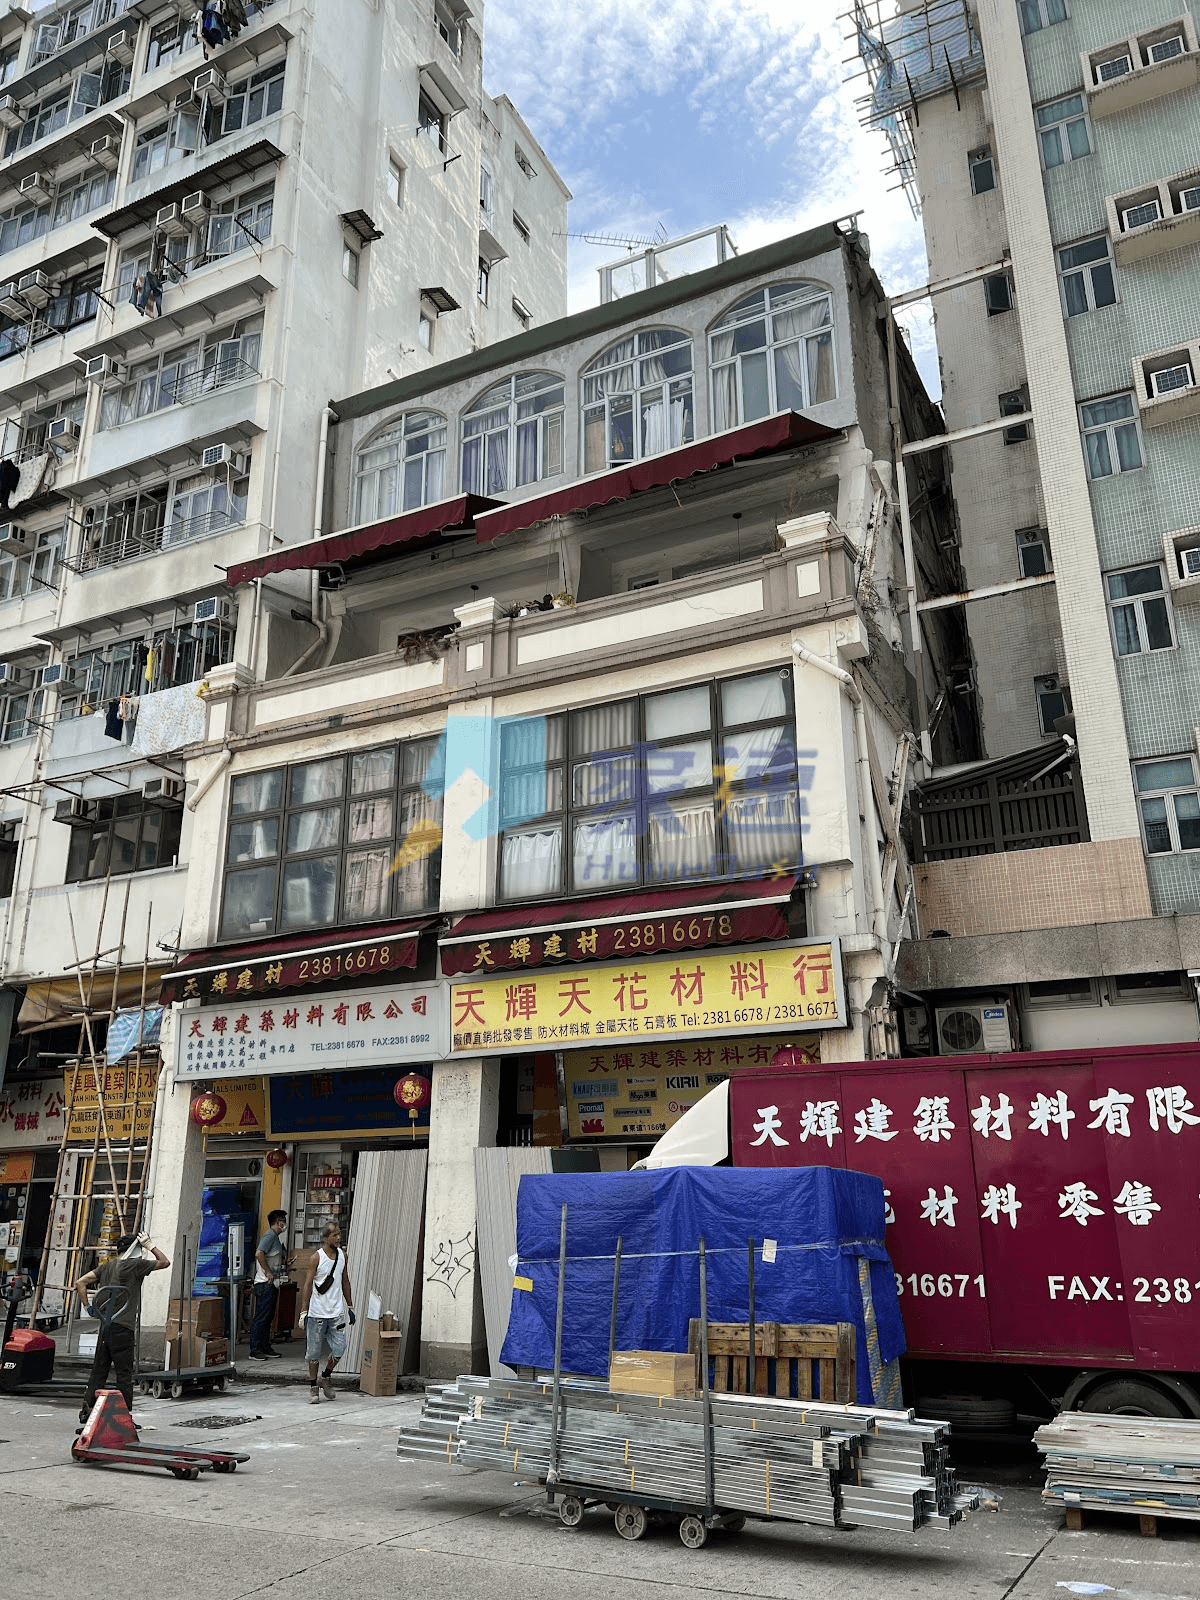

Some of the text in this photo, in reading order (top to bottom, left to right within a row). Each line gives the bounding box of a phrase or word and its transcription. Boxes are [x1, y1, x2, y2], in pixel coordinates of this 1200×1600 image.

[474, 915, 733, 968] 天輝建材 23816678
[183, 946, 391, 998] 天輝建材 23816678
[453, 953, 833, 1027] 天輝天花材料行
[187, 995, 429, 1038] 天輝建築材料有限公司
[453, 1026, 533, 1046] 廠價直銷批發零售
[537, 1022, 590, 1039] 防火材料城
[595, 1017, 639, 1034] 金屬天花
[643, 1014, 678, 1030] 石膏板
[681, 1012, 701, 1026] Tel:
[703, 1010, 731, 1025] 2381
[734, 1007, 763, 1022] 6678
[774, 1004, 804, 1019] 2381
[807, 1001, 838, 1017] 6671
[18, 1082, 43, 1101] 材料
[230, 1083, 257, 1092] LIMITED
[665, 1075, 700, 1089] KIRII
[44, 1090, 64, 1118] 公
[578, 1103, 604, 1114] Promat
[749, 1084, 1200, 1148] 天輝建築材料有限
[1057, 1180, 1162, 1227] 零售
[1047, 1275, 1124, 1302] FAX:
